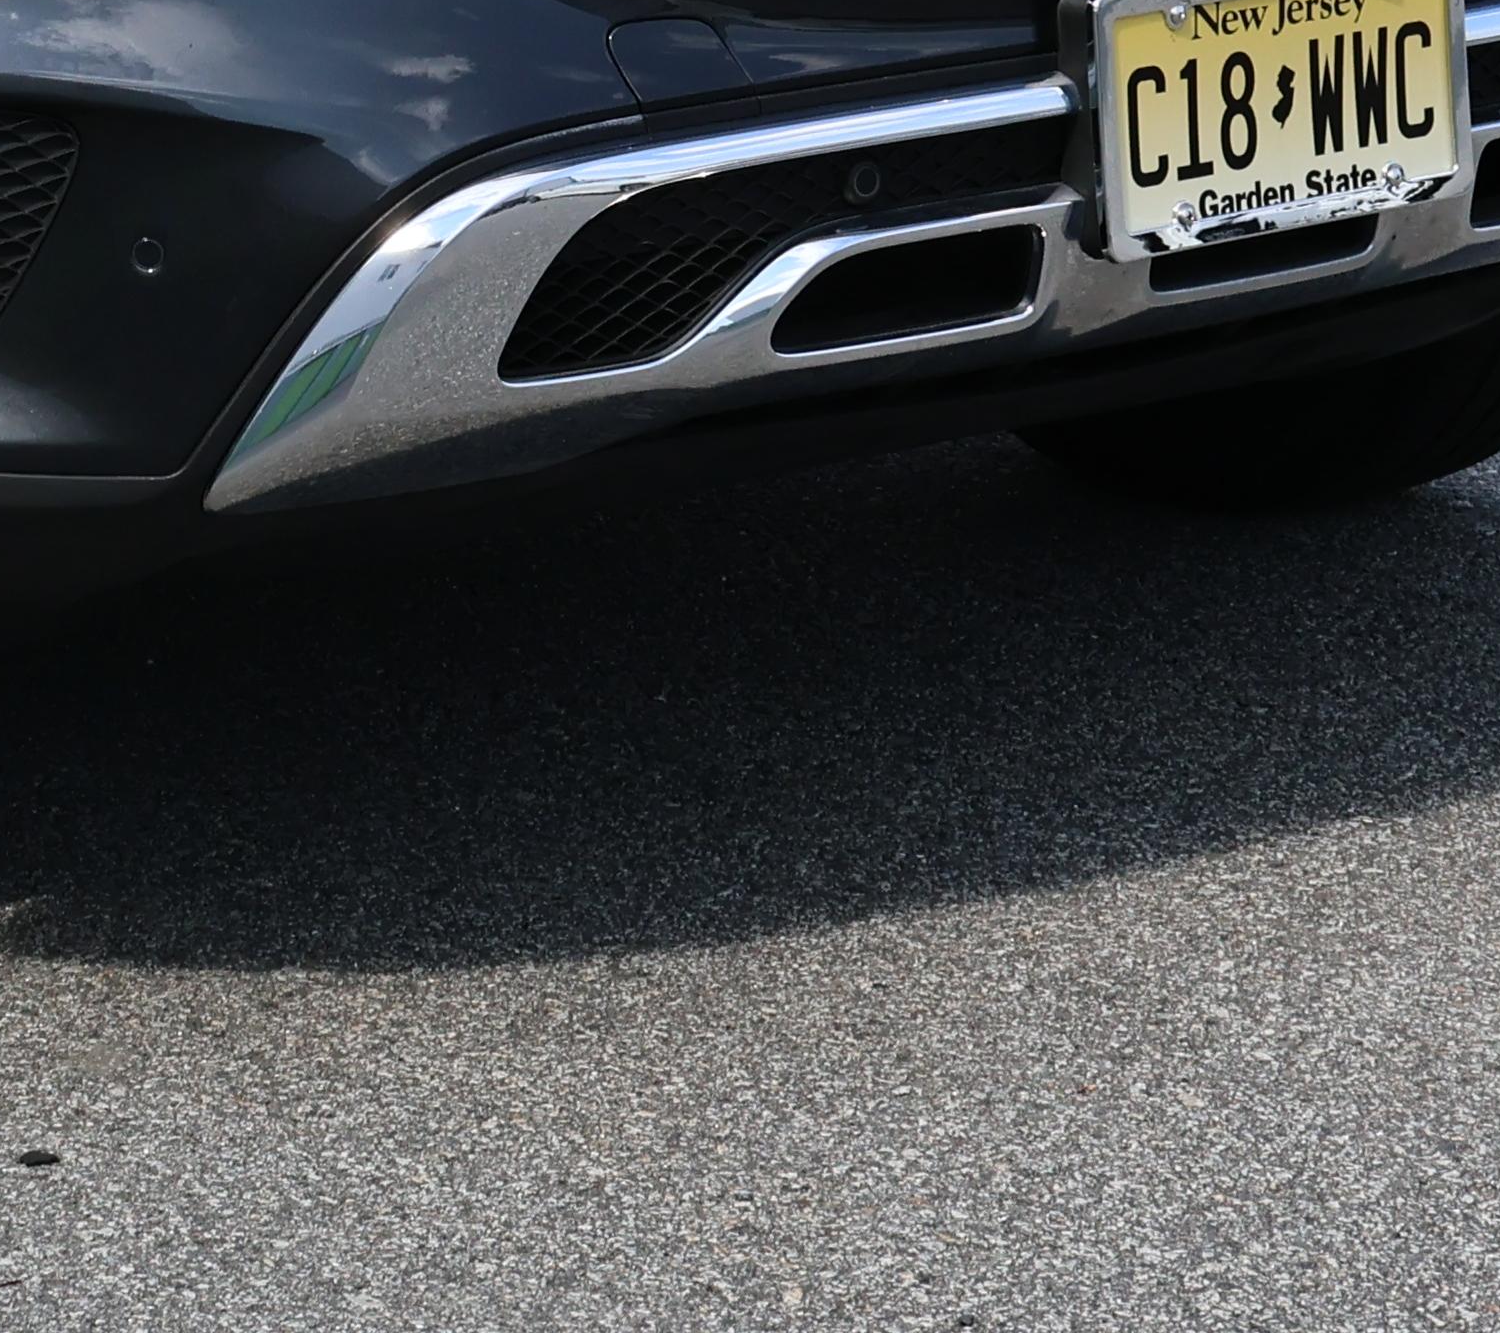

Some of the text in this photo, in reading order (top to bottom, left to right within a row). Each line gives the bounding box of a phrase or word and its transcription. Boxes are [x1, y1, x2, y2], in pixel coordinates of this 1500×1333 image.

[1192, 1, 1268, 40] New
[1127, 20, 1435, 189] C18 WWC
[1199, 163, 1376, 219] Garden State
